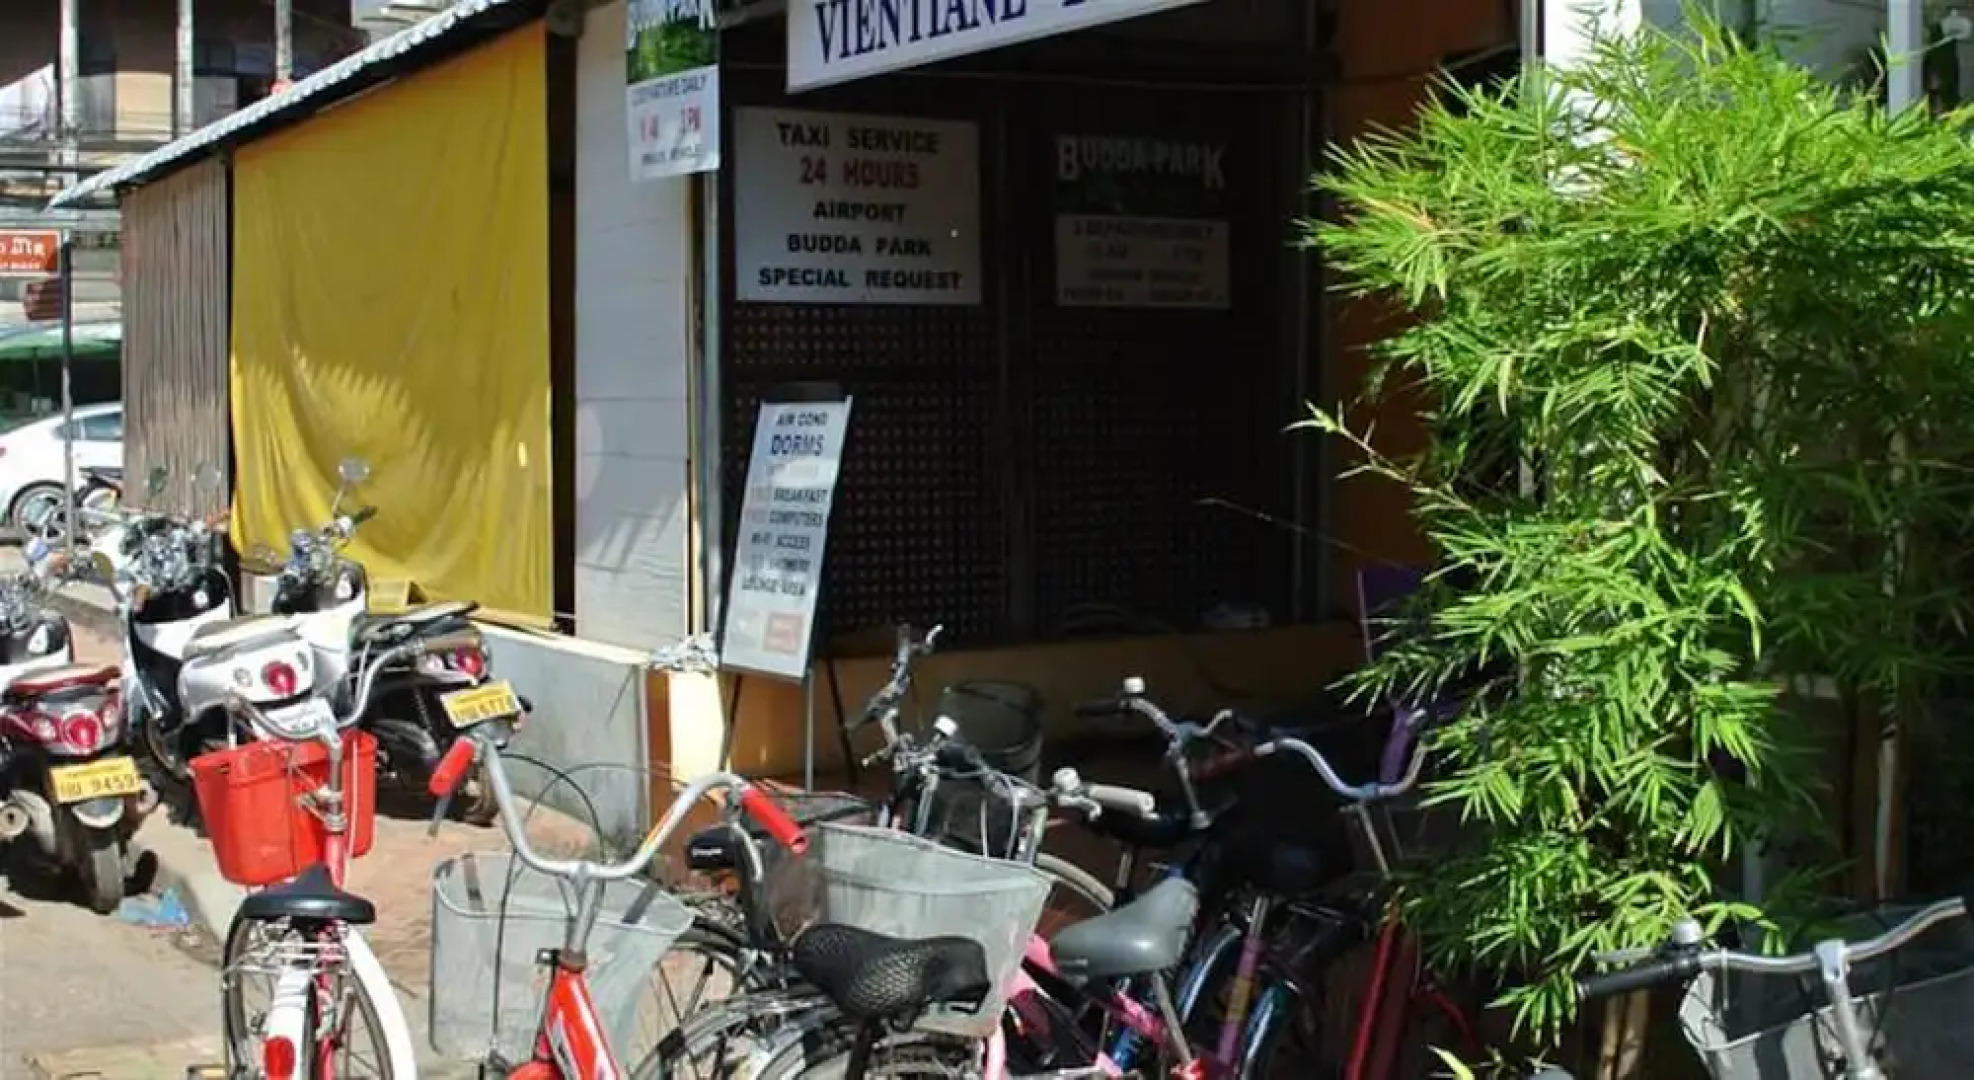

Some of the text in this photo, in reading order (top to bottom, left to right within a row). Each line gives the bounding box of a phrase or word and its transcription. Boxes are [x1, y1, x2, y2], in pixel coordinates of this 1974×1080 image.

[777, 121, 940, 154] TAXI SERVICE
[799, 157, 920, 188] 24 HOURS
[813, 200, 907, 221] AIRPORT
[787, 233, 932, 256] BUDDA PARK
[758, 267, 963, 290] SPECIAL REQUEST
[776, 411, 828, 427] AIR COND
[771, 433, 825, 456] DORMS
[774, 488, 828, 502] BREAKFAST
